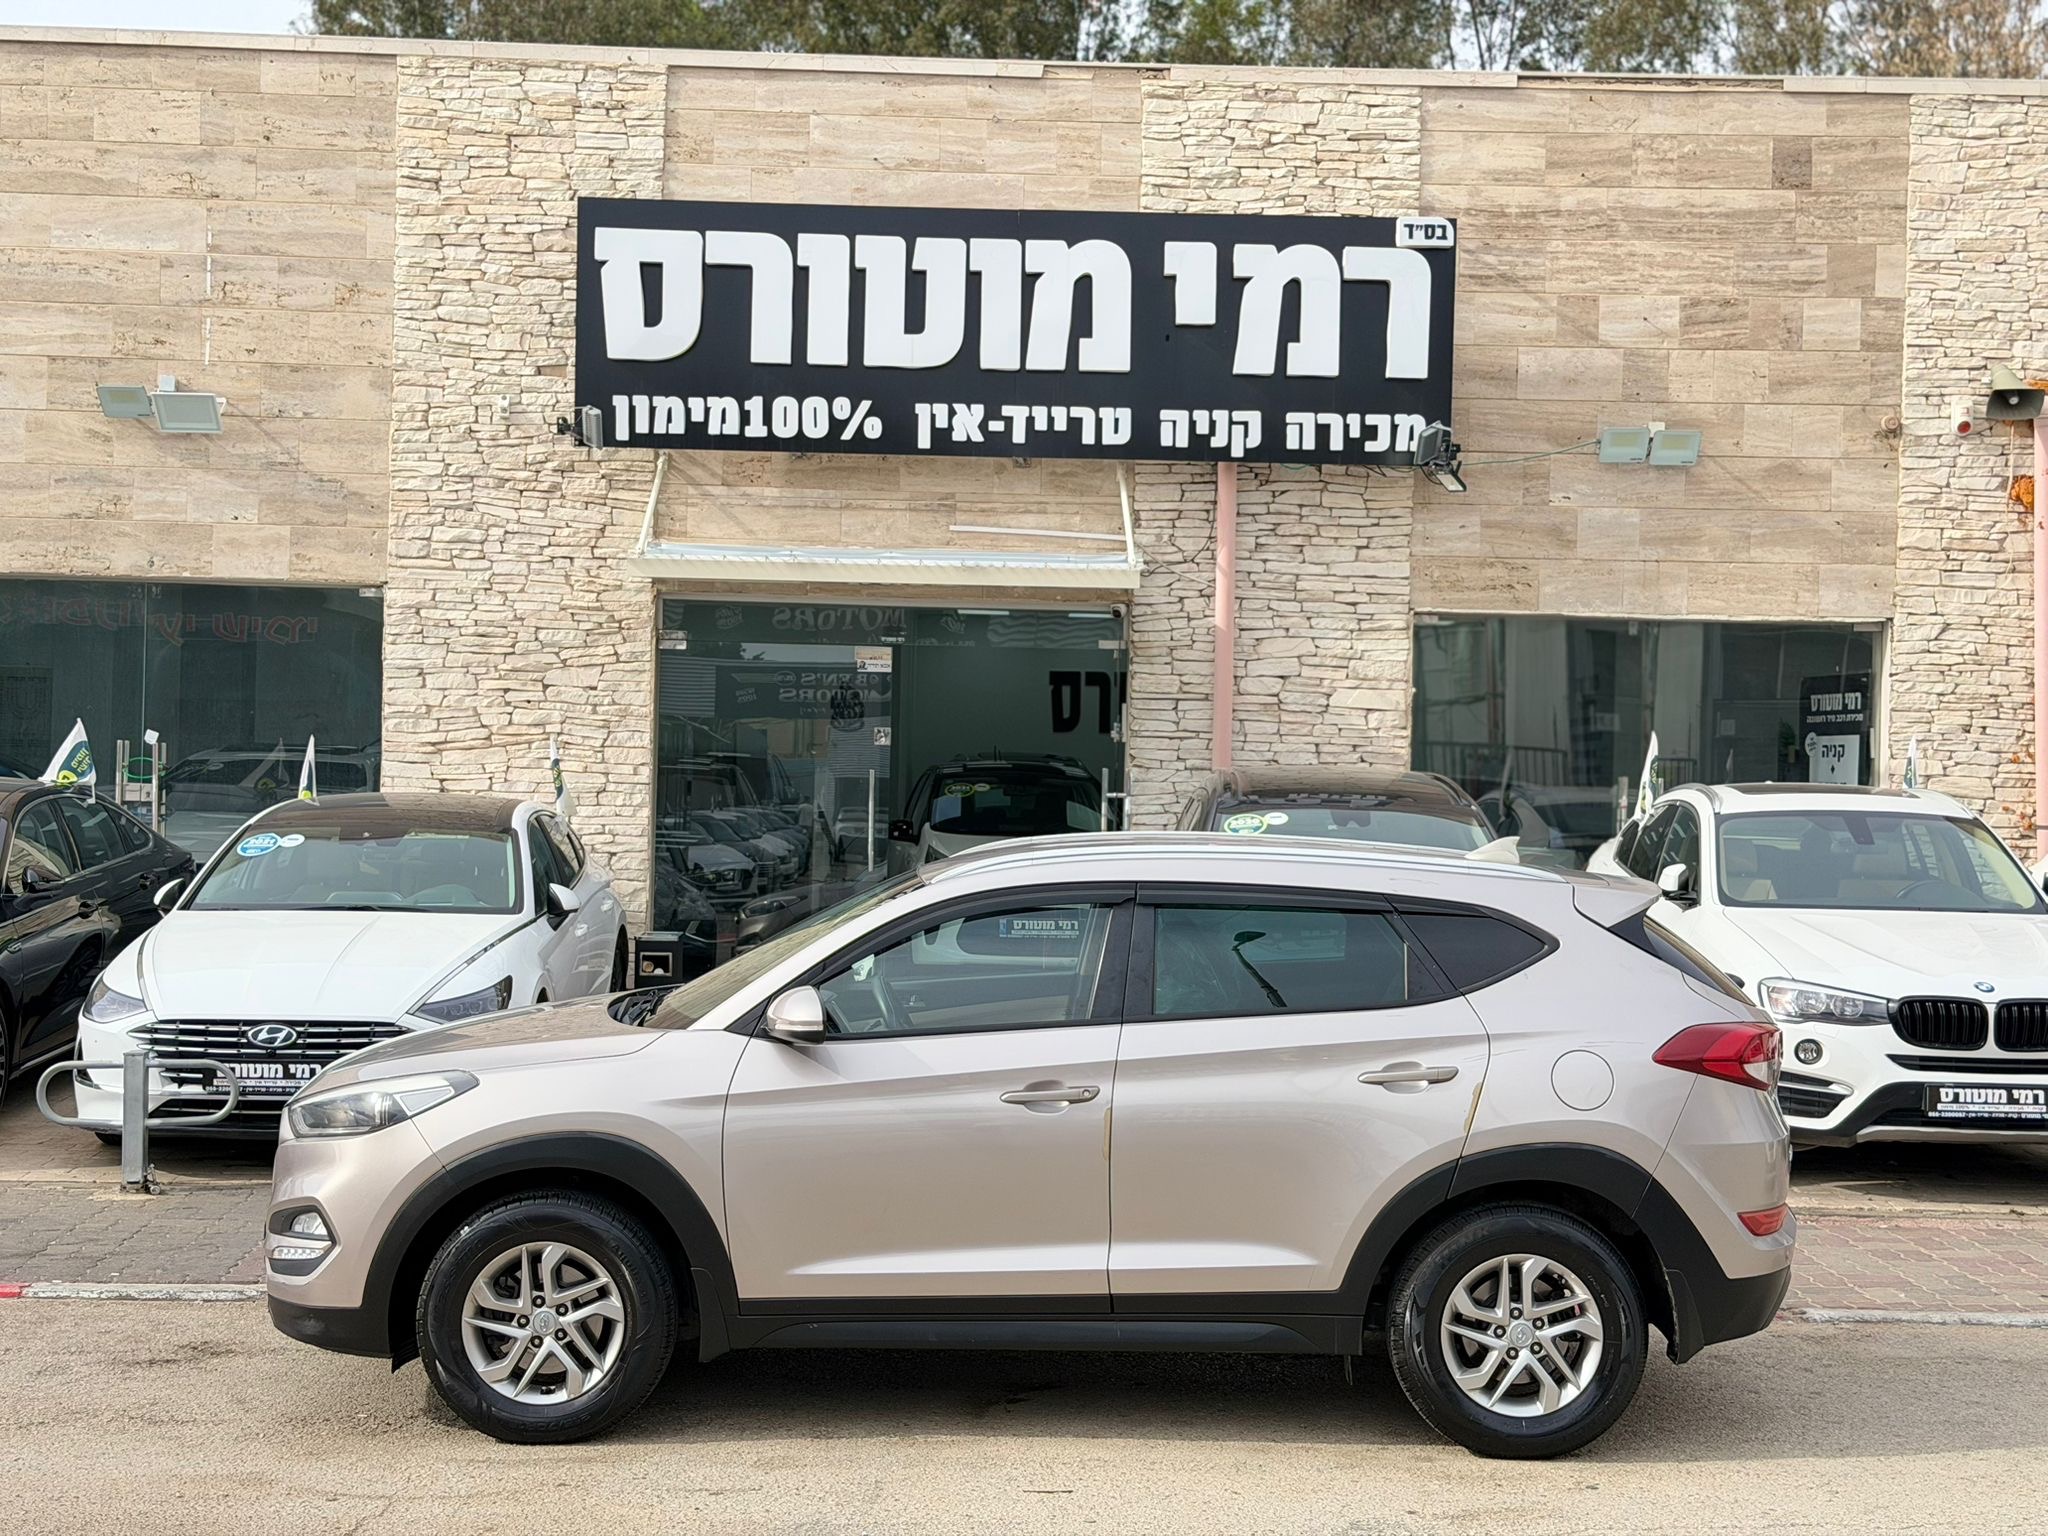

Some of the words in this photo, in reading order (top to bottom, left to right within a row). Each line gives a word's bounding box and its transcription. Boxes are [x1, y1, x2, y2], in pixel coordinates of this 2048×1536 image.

[594, 226, 1132, 374] מוטורס
[1164, 242, 1432, 379] רמי
[1160, 408, 1262, 458] קניה
[1286, 411, 1427, 453] מכירה
[1844, 692, 1862, 710] רמי
[1821, 744, 1846, 763] קניה
[1939, 1088, 2008, 1104] מוטורס
[2011, 1089, 2045, 1104] רמי
